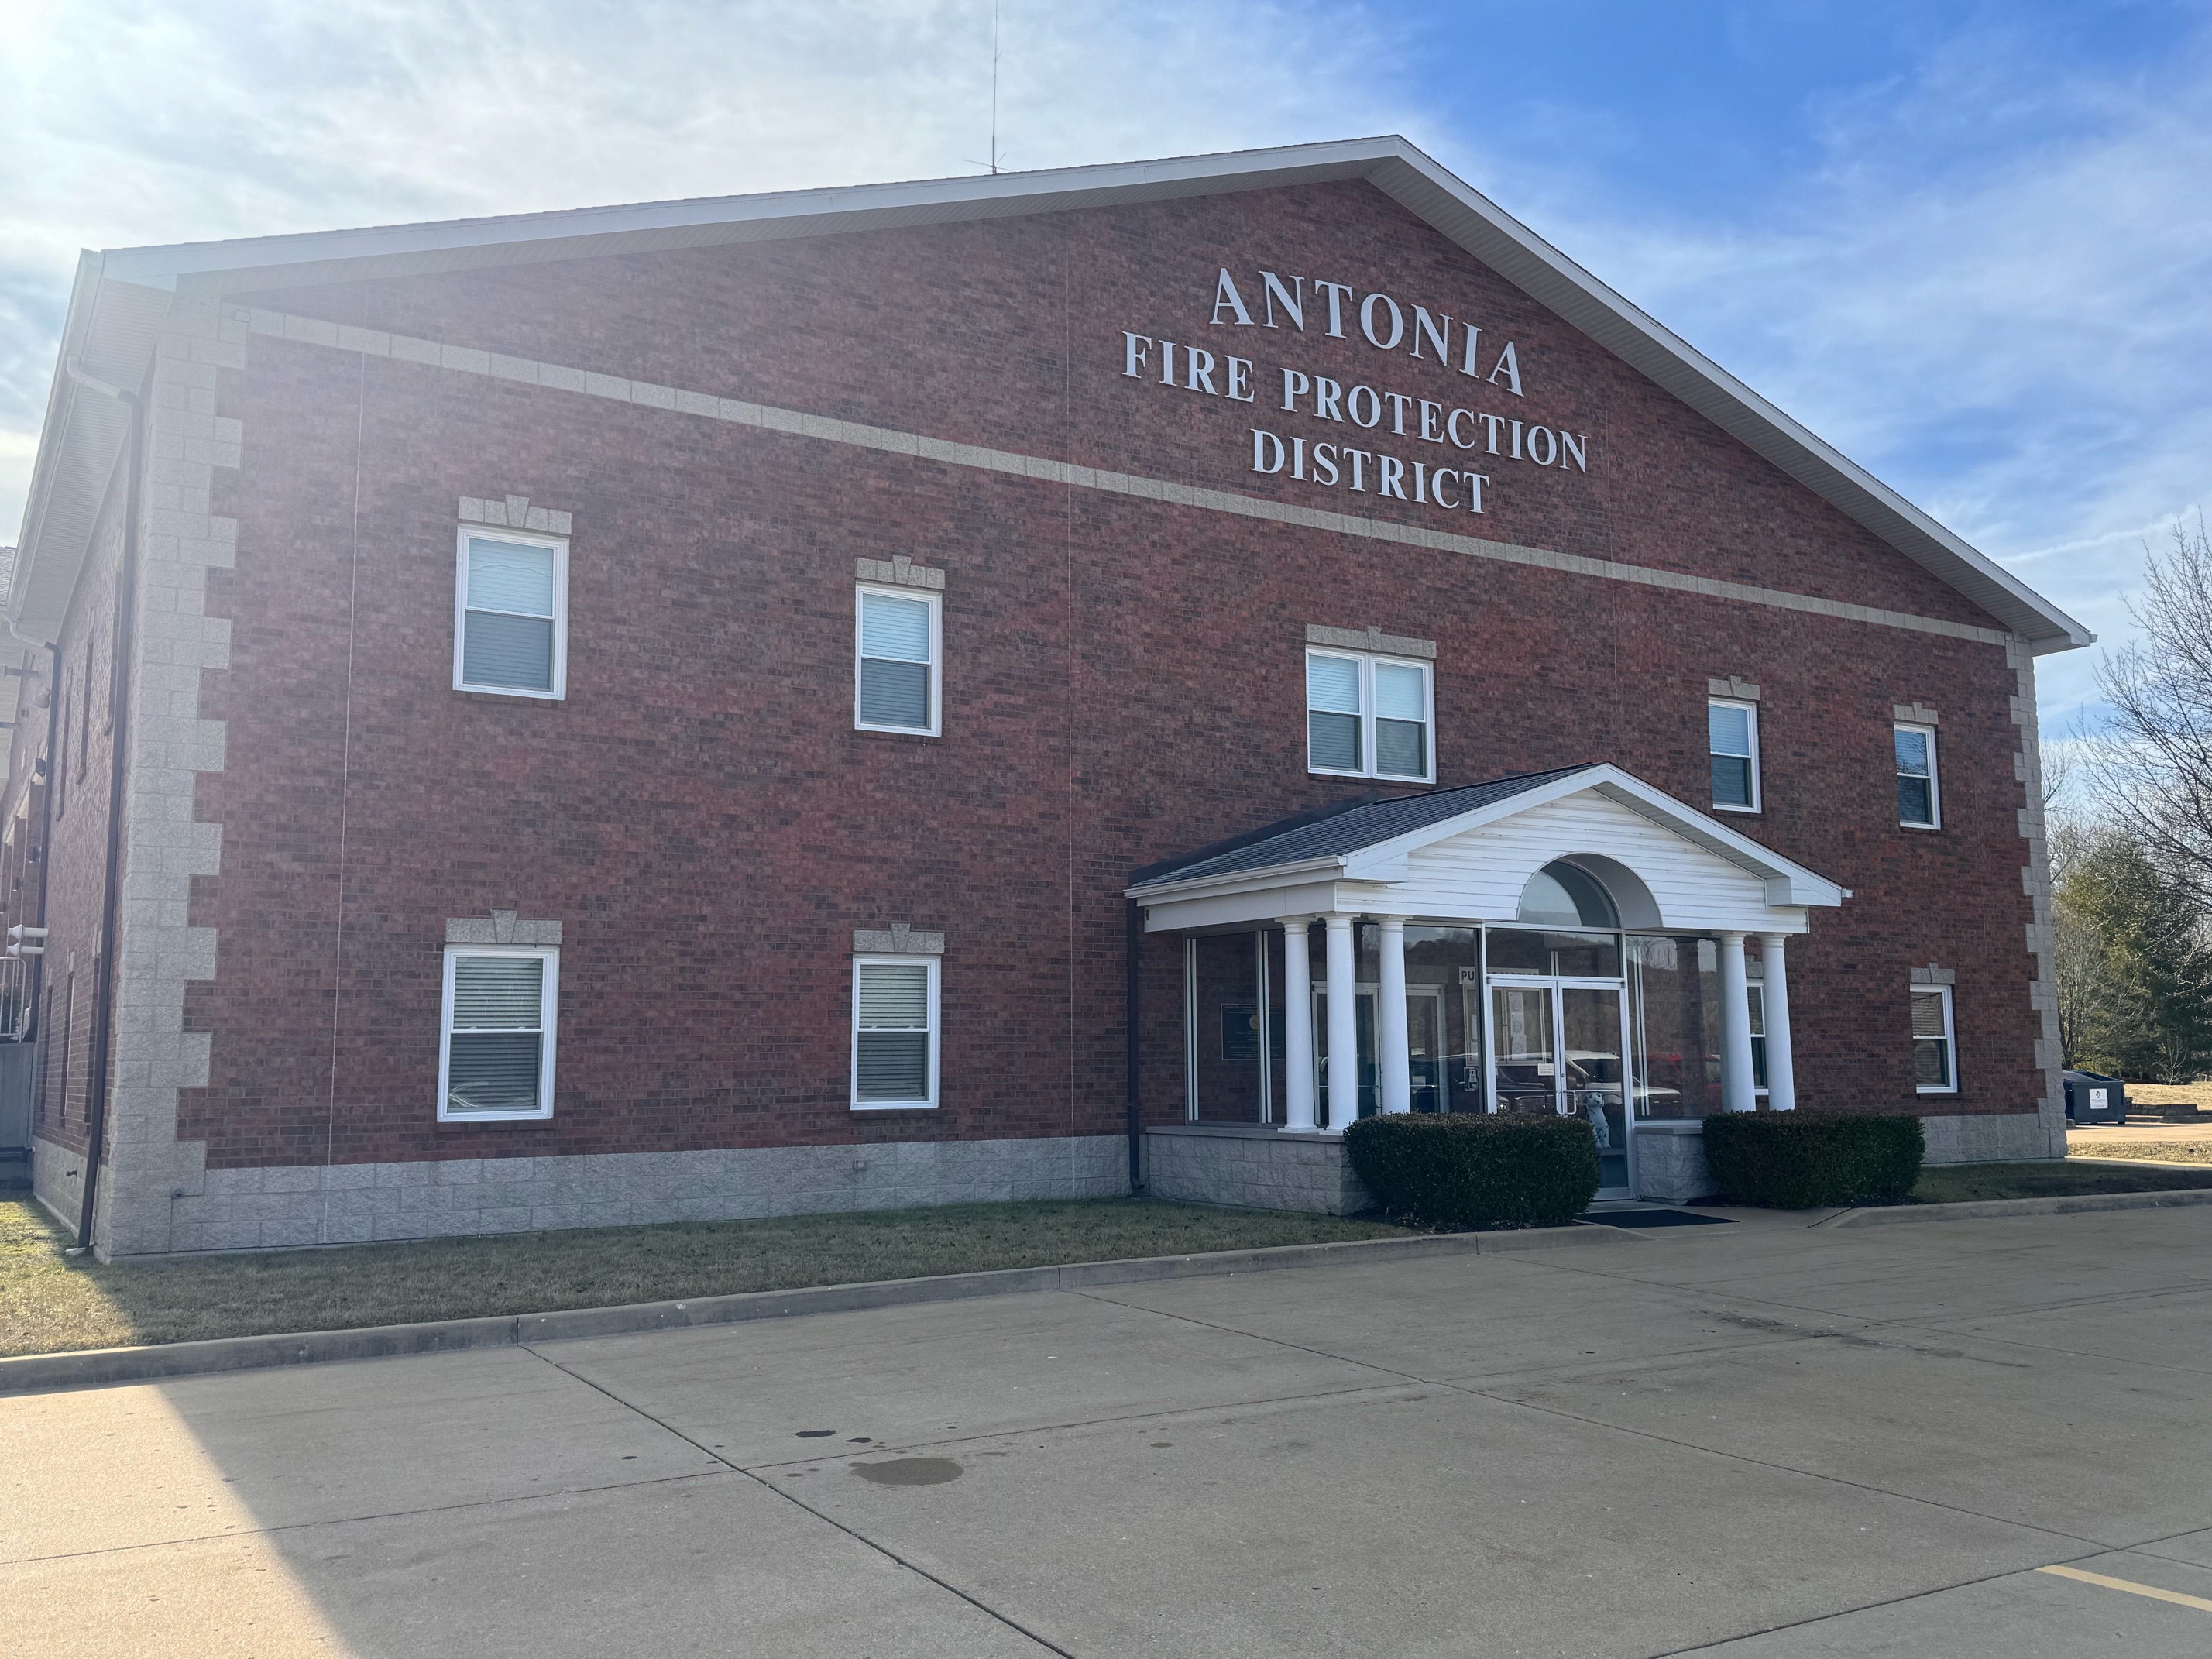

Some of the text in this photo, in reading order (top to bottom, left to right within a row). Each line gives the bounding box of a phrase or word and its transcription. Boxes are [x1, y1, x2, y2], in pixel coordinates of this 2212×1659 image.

[1209, 267, 1525, 397] ANTONIA
[1121, 331, 1589, 473] FIRE PROTECTION
[1250, 428, 1490, 514] DISTRICT
